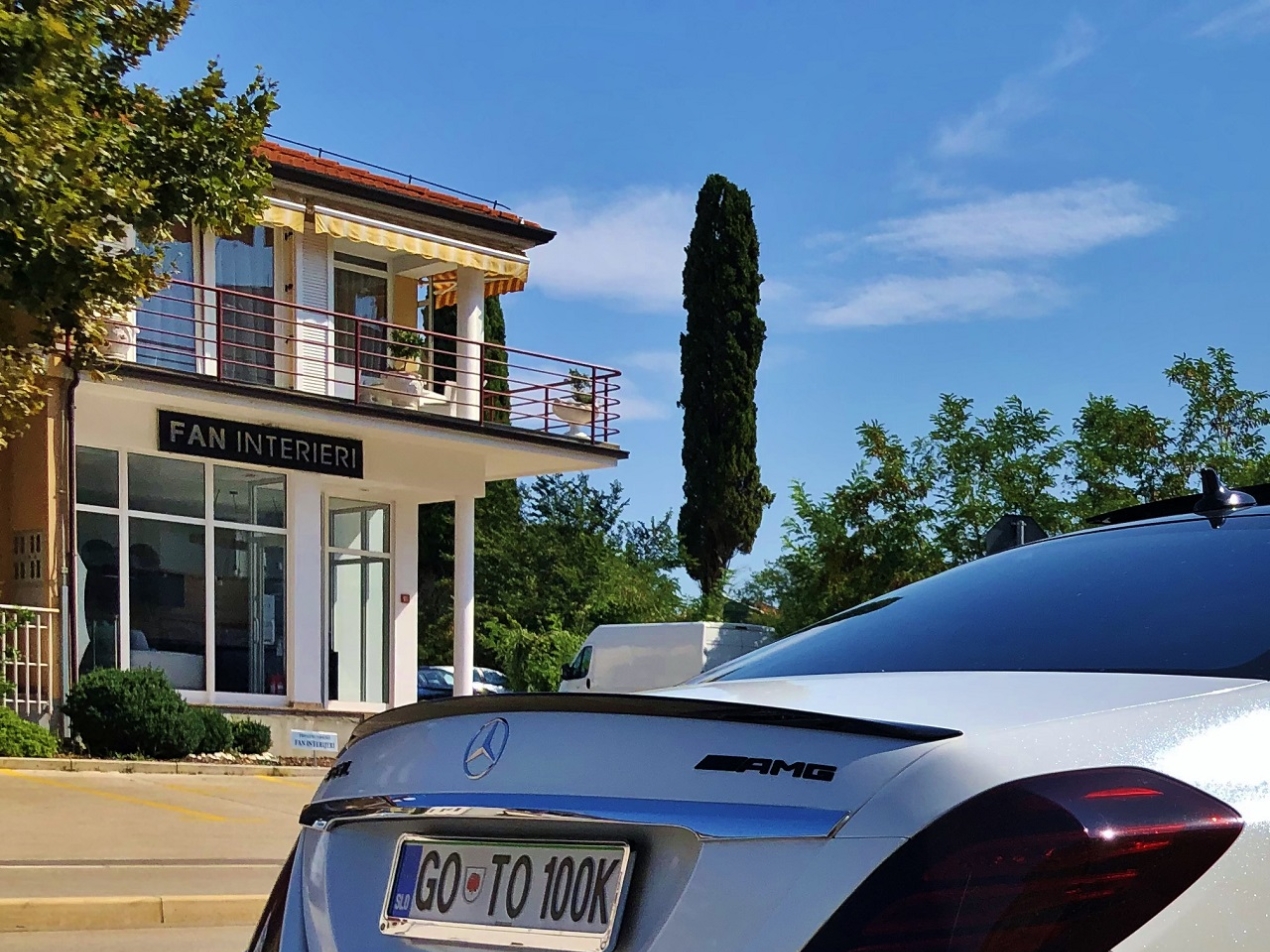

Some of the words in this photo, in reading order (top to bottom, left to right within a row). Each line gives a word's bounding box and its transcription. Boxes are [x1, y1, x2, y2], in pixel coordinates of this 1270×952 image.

[169, 420, 226, 450] FAN
[237, 430, 356, 469] INTERIERI
[736, 756, 838, 783] AMG
[394, 893, 411, 911] SLO
[415, 850, 461, 914] GO
[487, 853, 533, 919] TO
[540, 855, 620, 925] 100K
